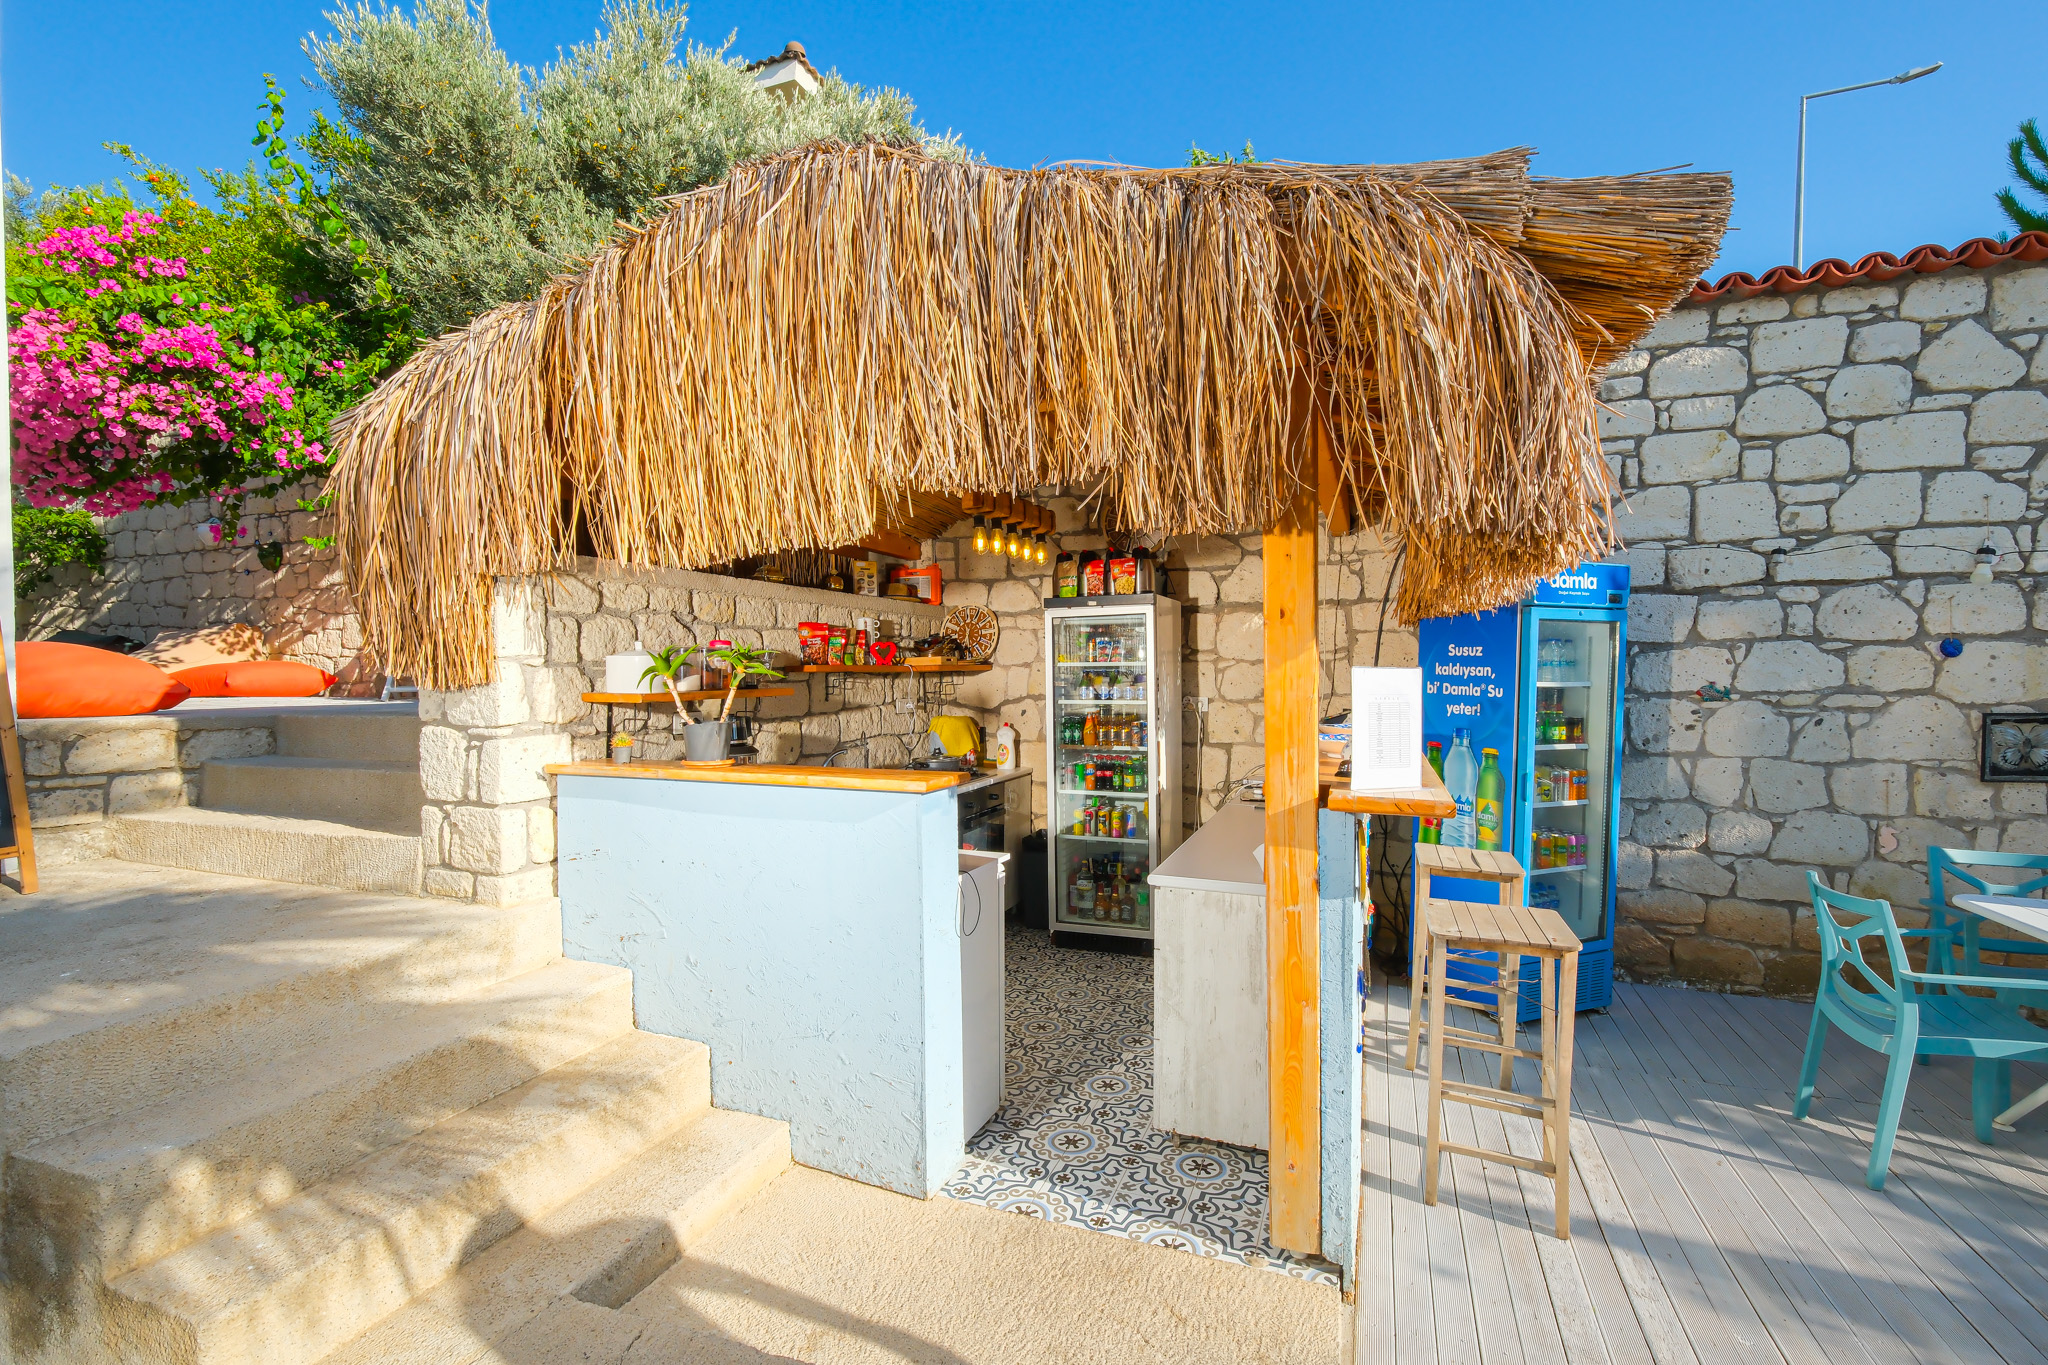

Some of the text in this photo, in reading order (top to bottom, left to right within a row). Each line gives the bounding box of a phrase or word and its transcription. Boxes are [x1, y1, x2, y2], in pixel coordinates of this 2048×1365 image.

[1448, 643, 1483, 656] Susuz
[1435, 662, 1496, 679] kaldıysan,
[1487, 684, 1504, 698] Su
[1446, 702, 1481, 717] yeter!
